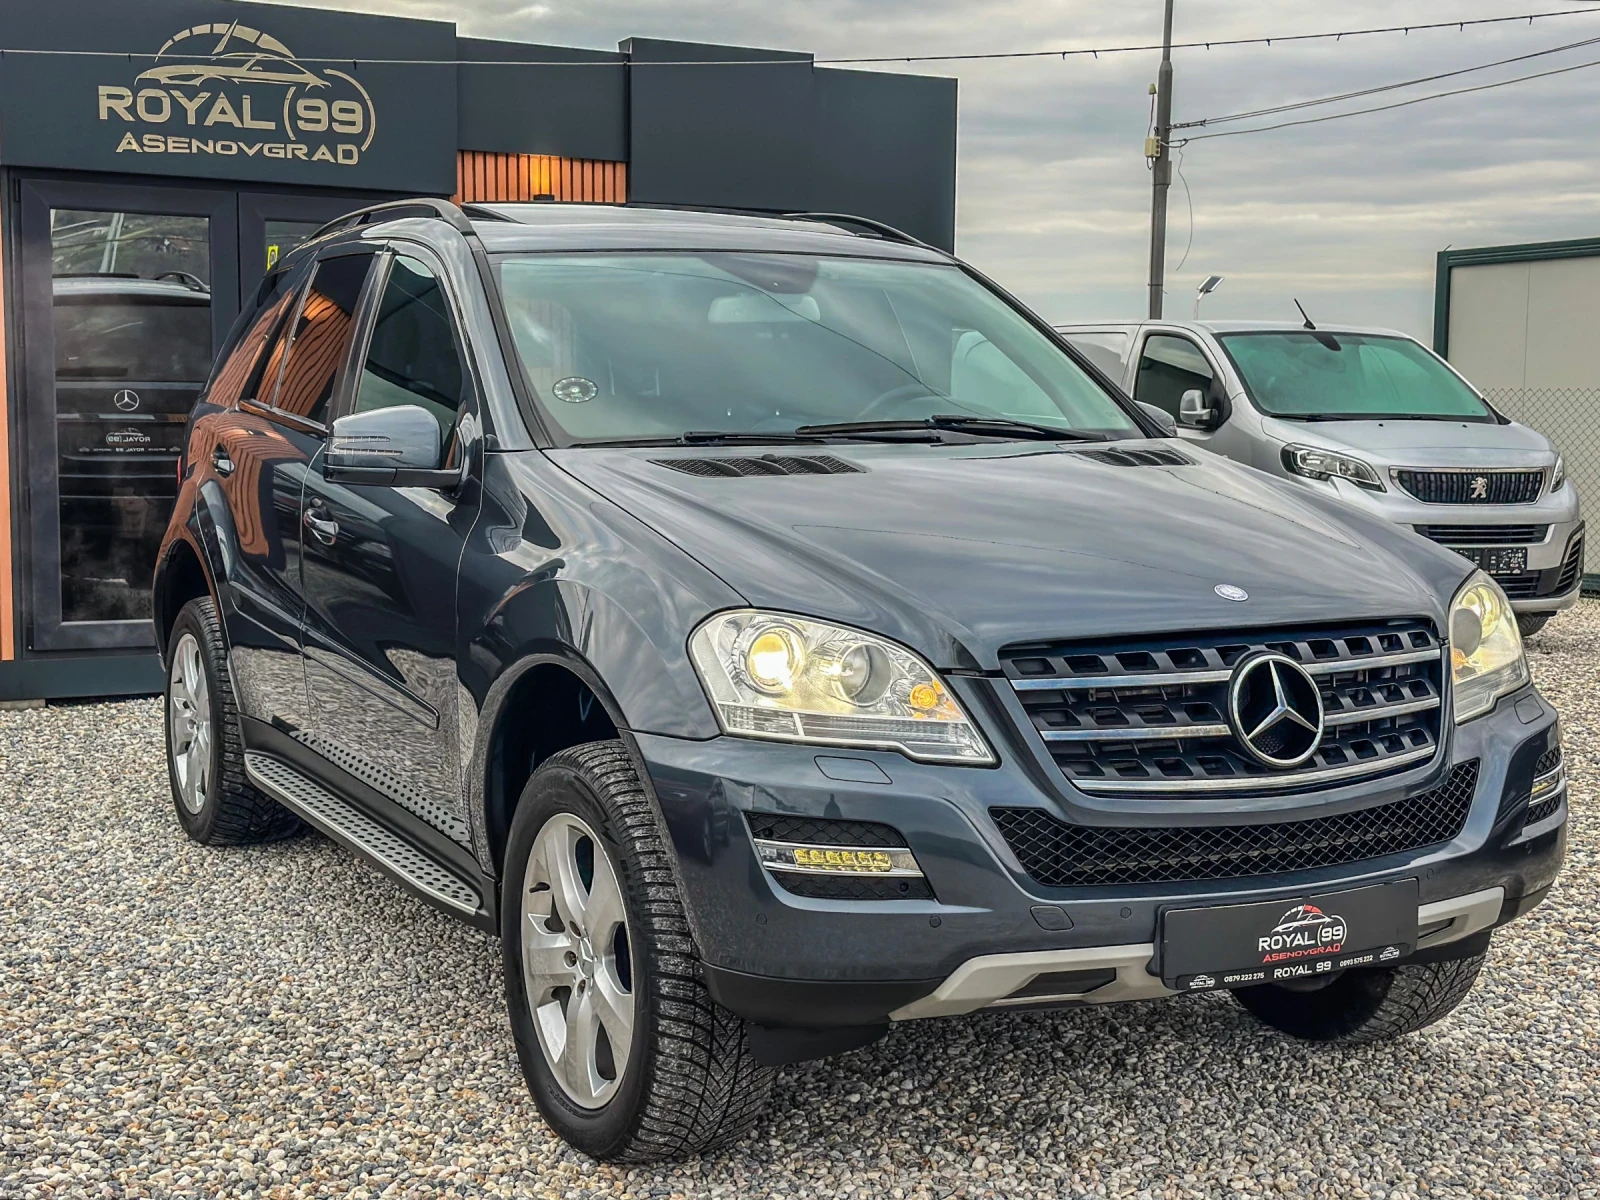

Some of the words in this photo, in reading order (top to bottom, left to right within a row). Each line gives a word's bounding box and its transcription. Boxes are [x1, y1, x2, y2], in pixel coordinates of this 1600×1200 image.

[98, 85, 276, 130] ROYAL
[115, 132, 359, 165] ASENOVGRAD
[1258, 931, 1315, 952] ROYAL
[1263, 943, 1341, 963] ASENOVGRAD
[1223, 974, 1240, 983] 0879
[1240, 973, 1252, 981] 222
[1253, 972, 1265, 980] 275
[1273, 964, 1312, 979] ROYAL
[1316, 961, 1332, 972] 99
